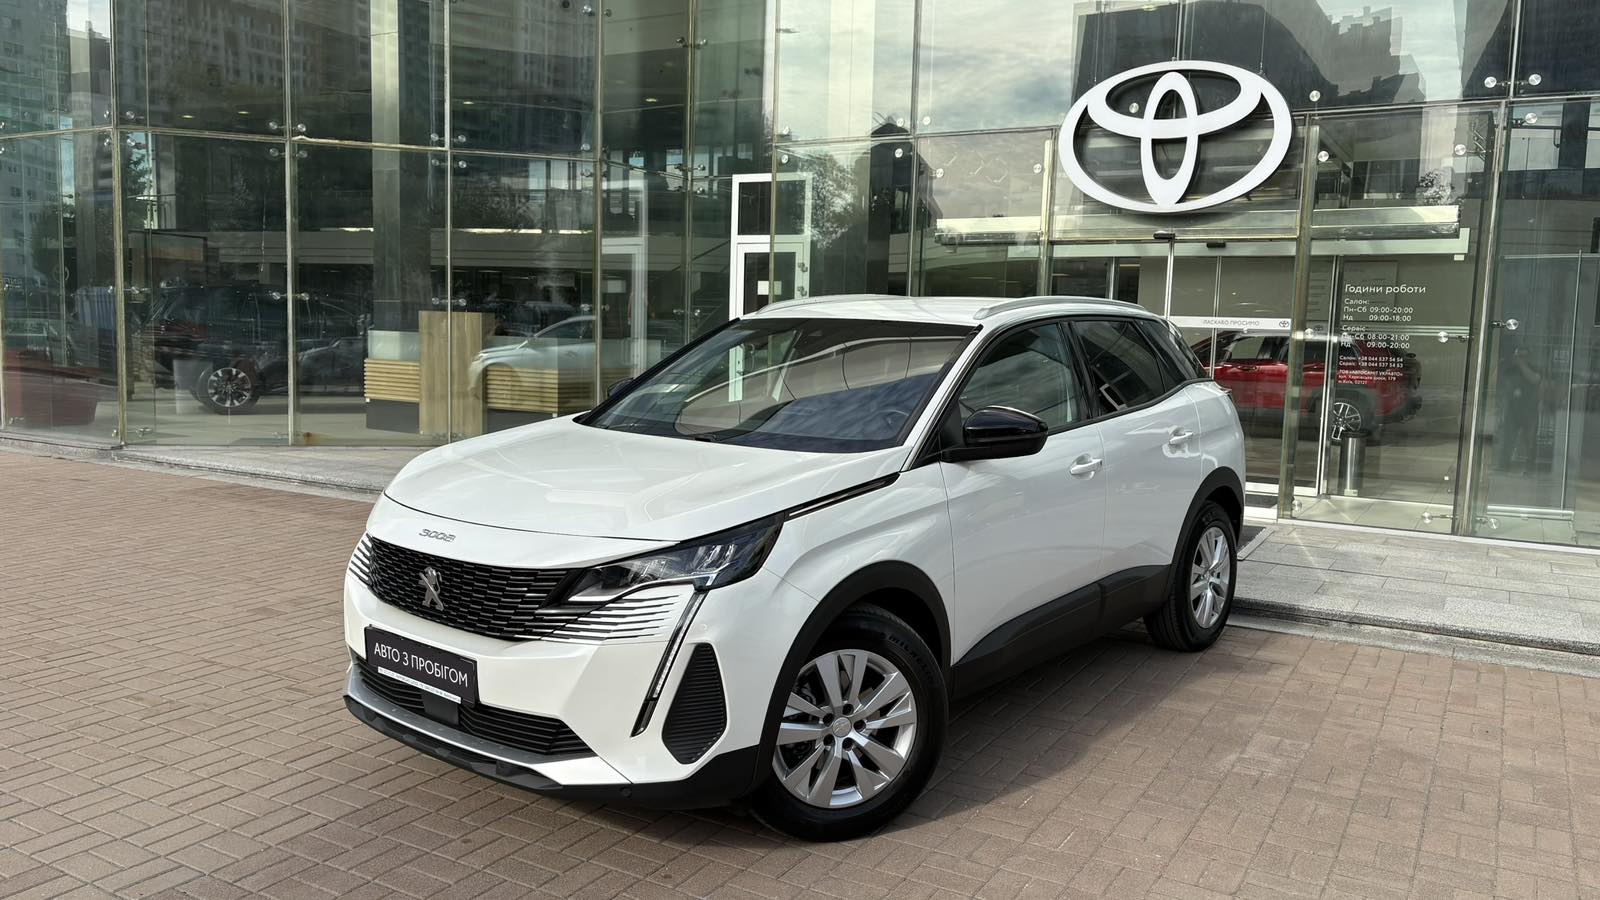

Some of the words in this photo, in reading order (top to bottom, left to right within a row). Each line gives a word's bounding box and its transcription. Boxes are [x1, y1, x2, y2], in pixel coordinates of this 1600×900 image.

[1345, 284, 1383, 294] Години
[1385, 284, 1426, 294] роботи
[418, 528, 456, 542] 3008
[374, 642, 401, 663] АВТО
[411, 654, 468, 688] ПРОБІГОМ
